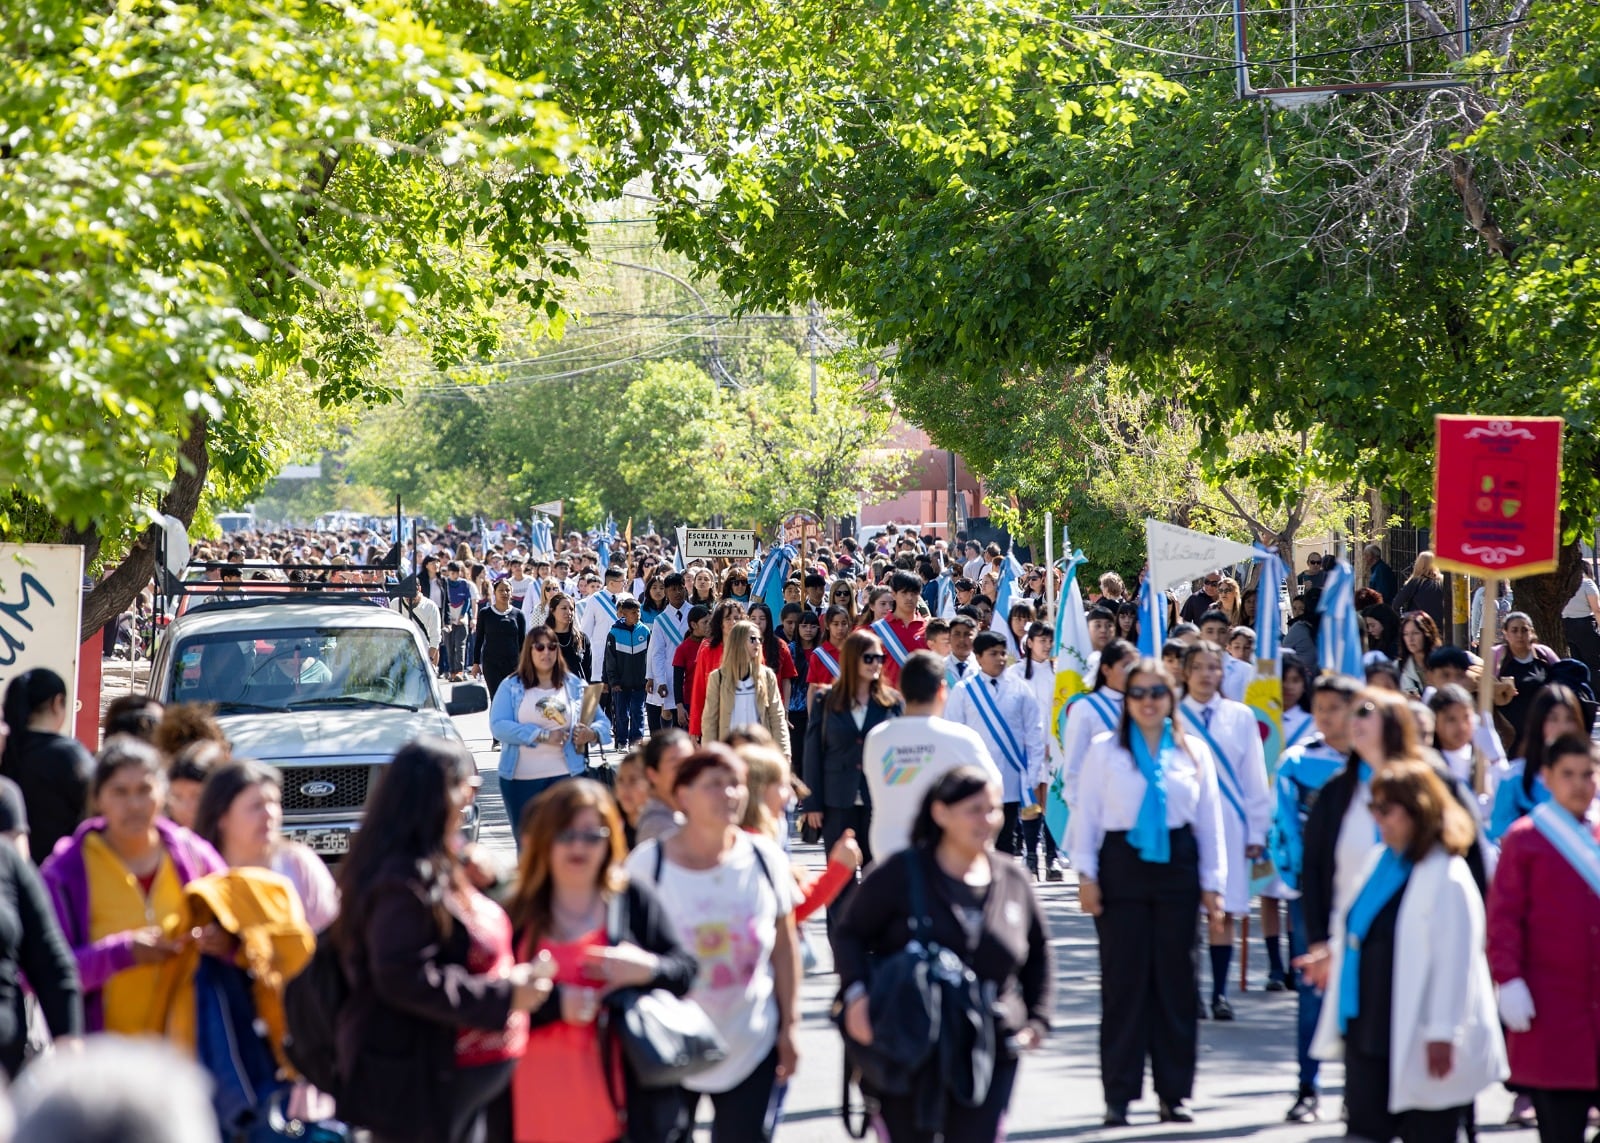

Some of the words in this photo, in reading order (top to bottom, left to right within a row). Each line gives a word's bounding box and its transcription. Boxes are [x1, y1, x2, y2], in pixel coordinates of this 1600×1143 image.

[688, 532, 719, 540] ESCUELA
[707, 548, 748, 556] ARGENTINA
[308, 784, 328, 794] Ford
